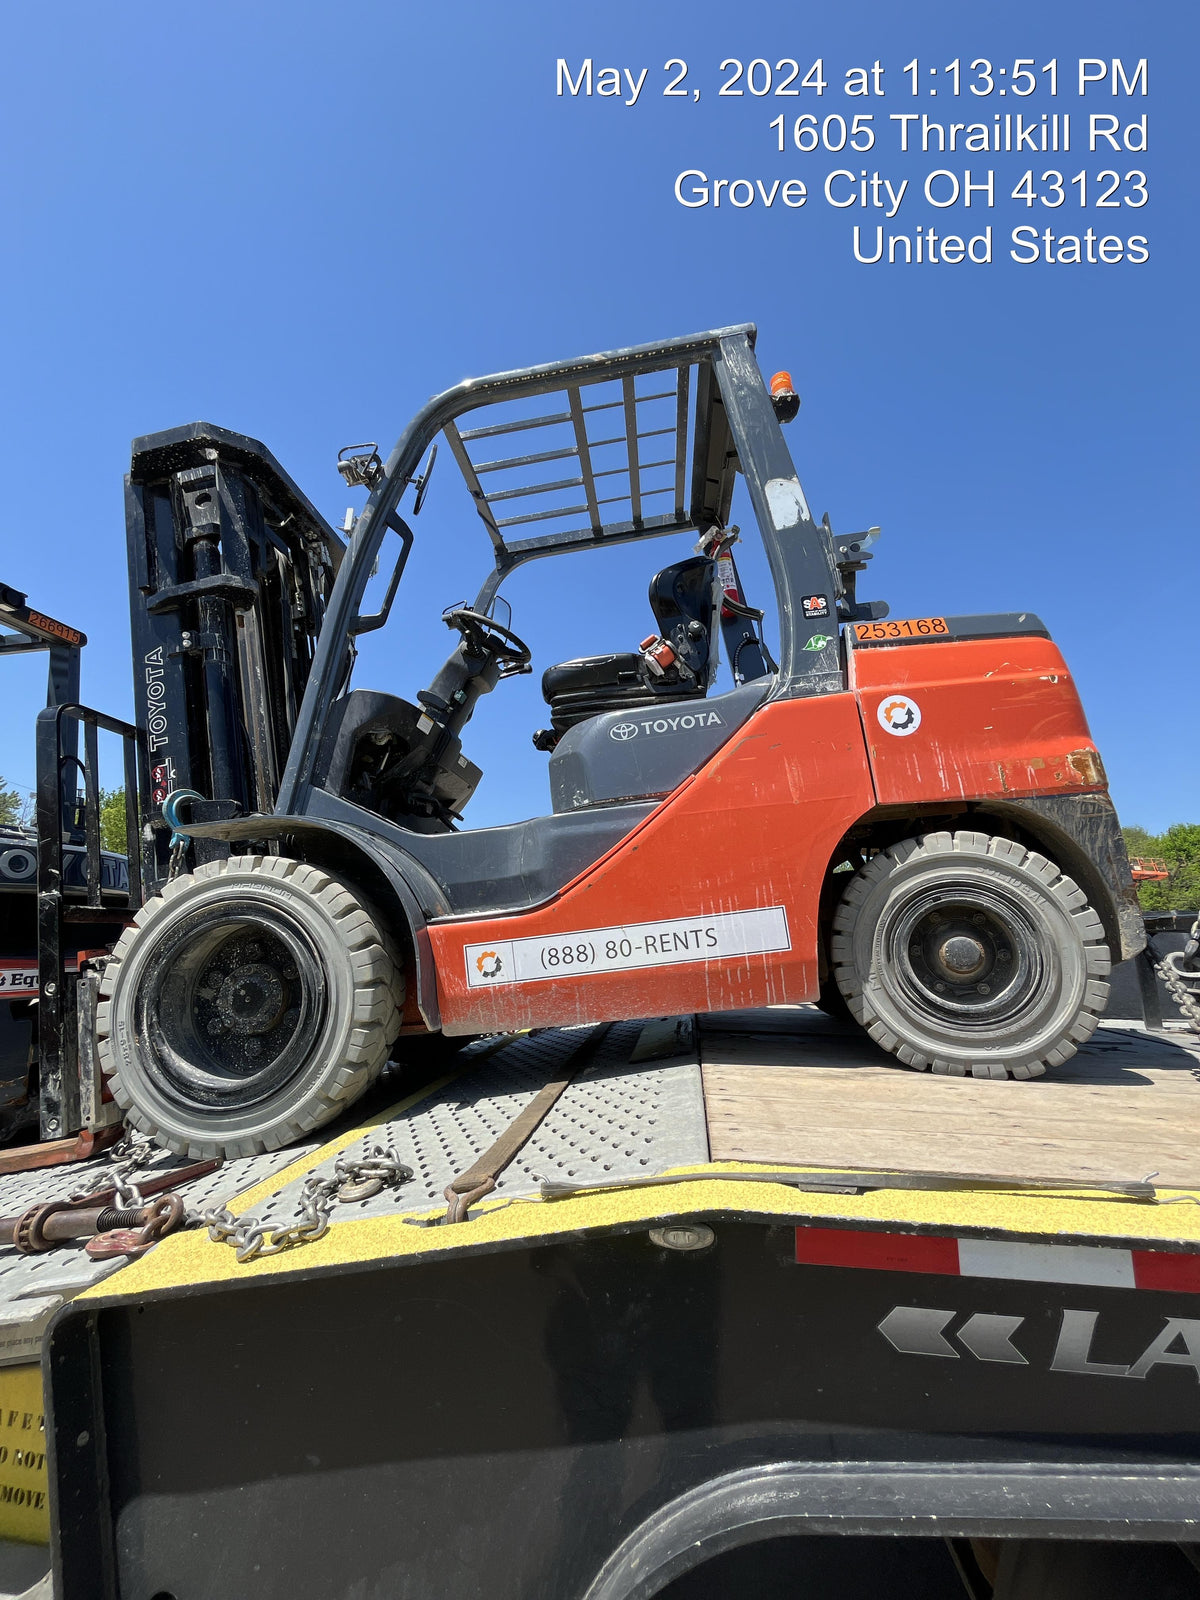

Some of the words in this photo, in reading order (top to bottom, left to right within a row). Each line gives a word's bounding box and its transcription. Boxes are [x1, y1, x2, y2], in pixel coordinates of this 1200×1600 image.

[803, 596, 827, 611] SAS
[30, 612, 79, 642] 266915
[857, 618, 946, 640] 253168
[145, 646, 169, 752] TOYOTA
[641, 711, 721, 735] TOYOTA
[540, 942, 596, 970] (888)
[605, 927, 718, 960] 80-RENTS
[1050, 1309, 1200, 1384] LA
[12, 1448, 45, 1471] NOT
[0, 1484, 46, 1510] MOVE
